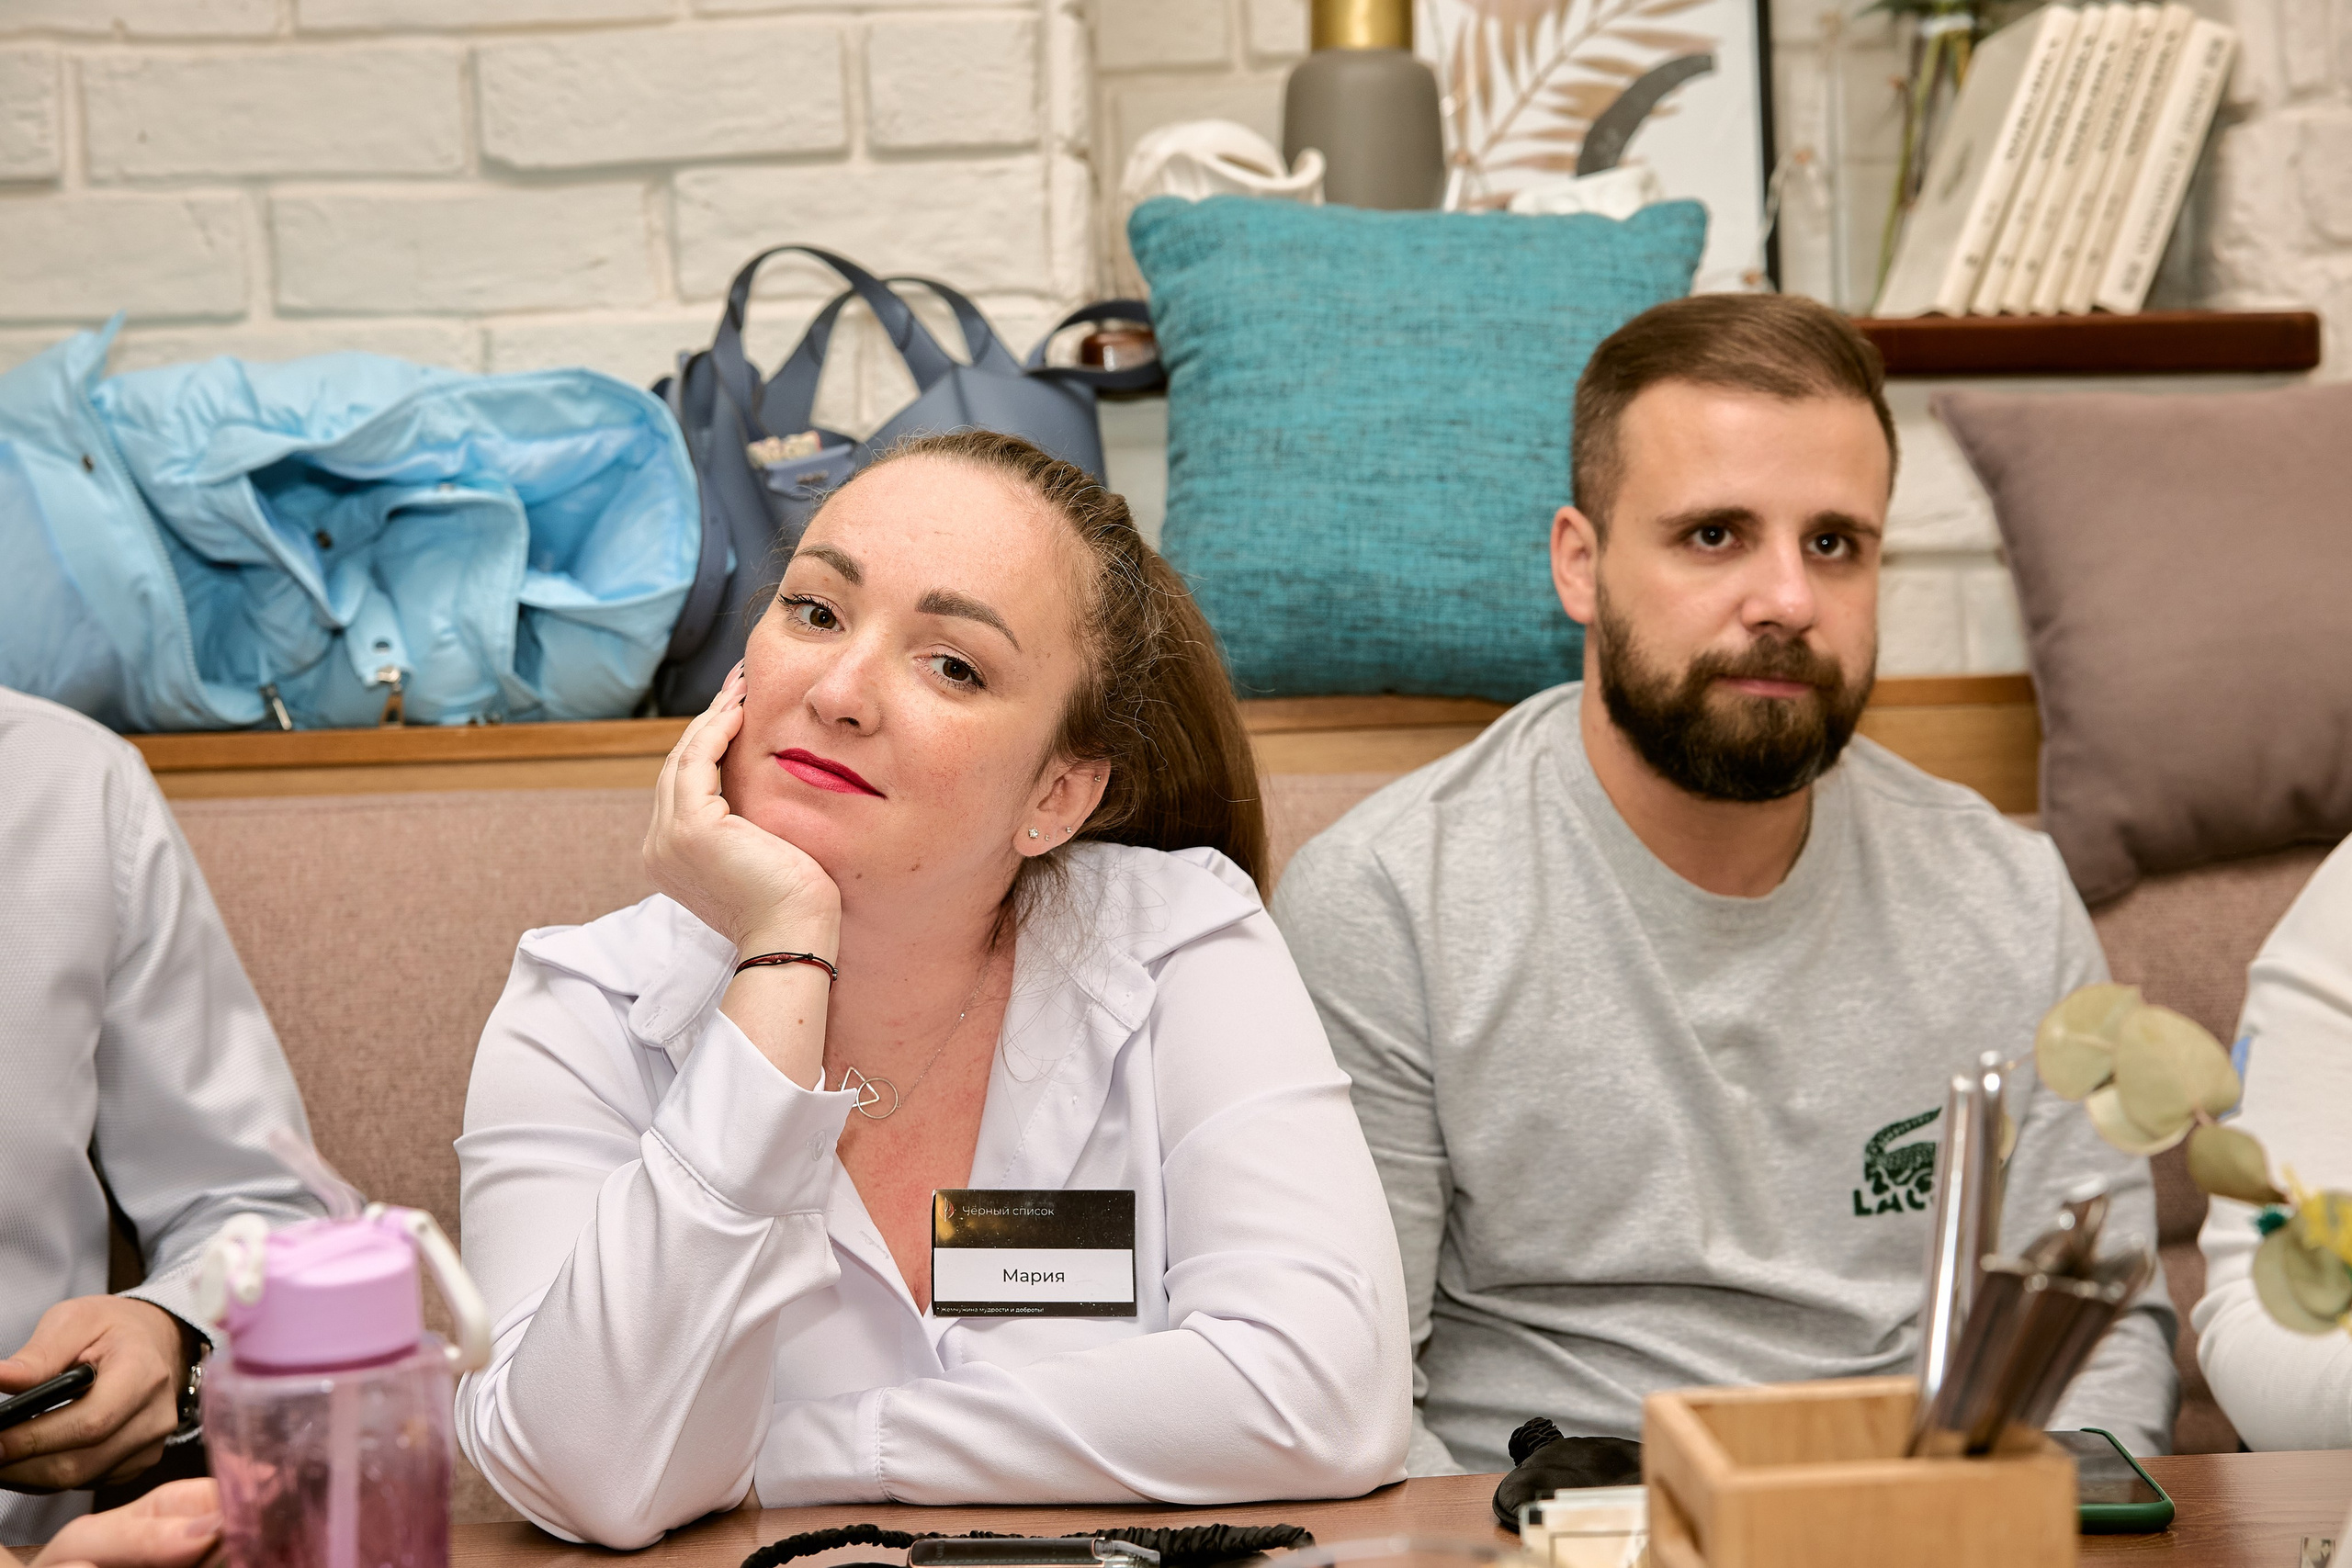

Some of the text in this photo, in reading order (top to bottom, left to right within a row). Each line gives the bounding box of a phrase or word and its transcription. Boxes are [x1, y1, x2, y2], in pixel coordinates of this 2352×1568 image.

[1853, 1189, 1933, 1215] LAC
[962, 1205, 1055, 1217] Чёрный список
[1002, 1269, 1065, 1285] Мария
